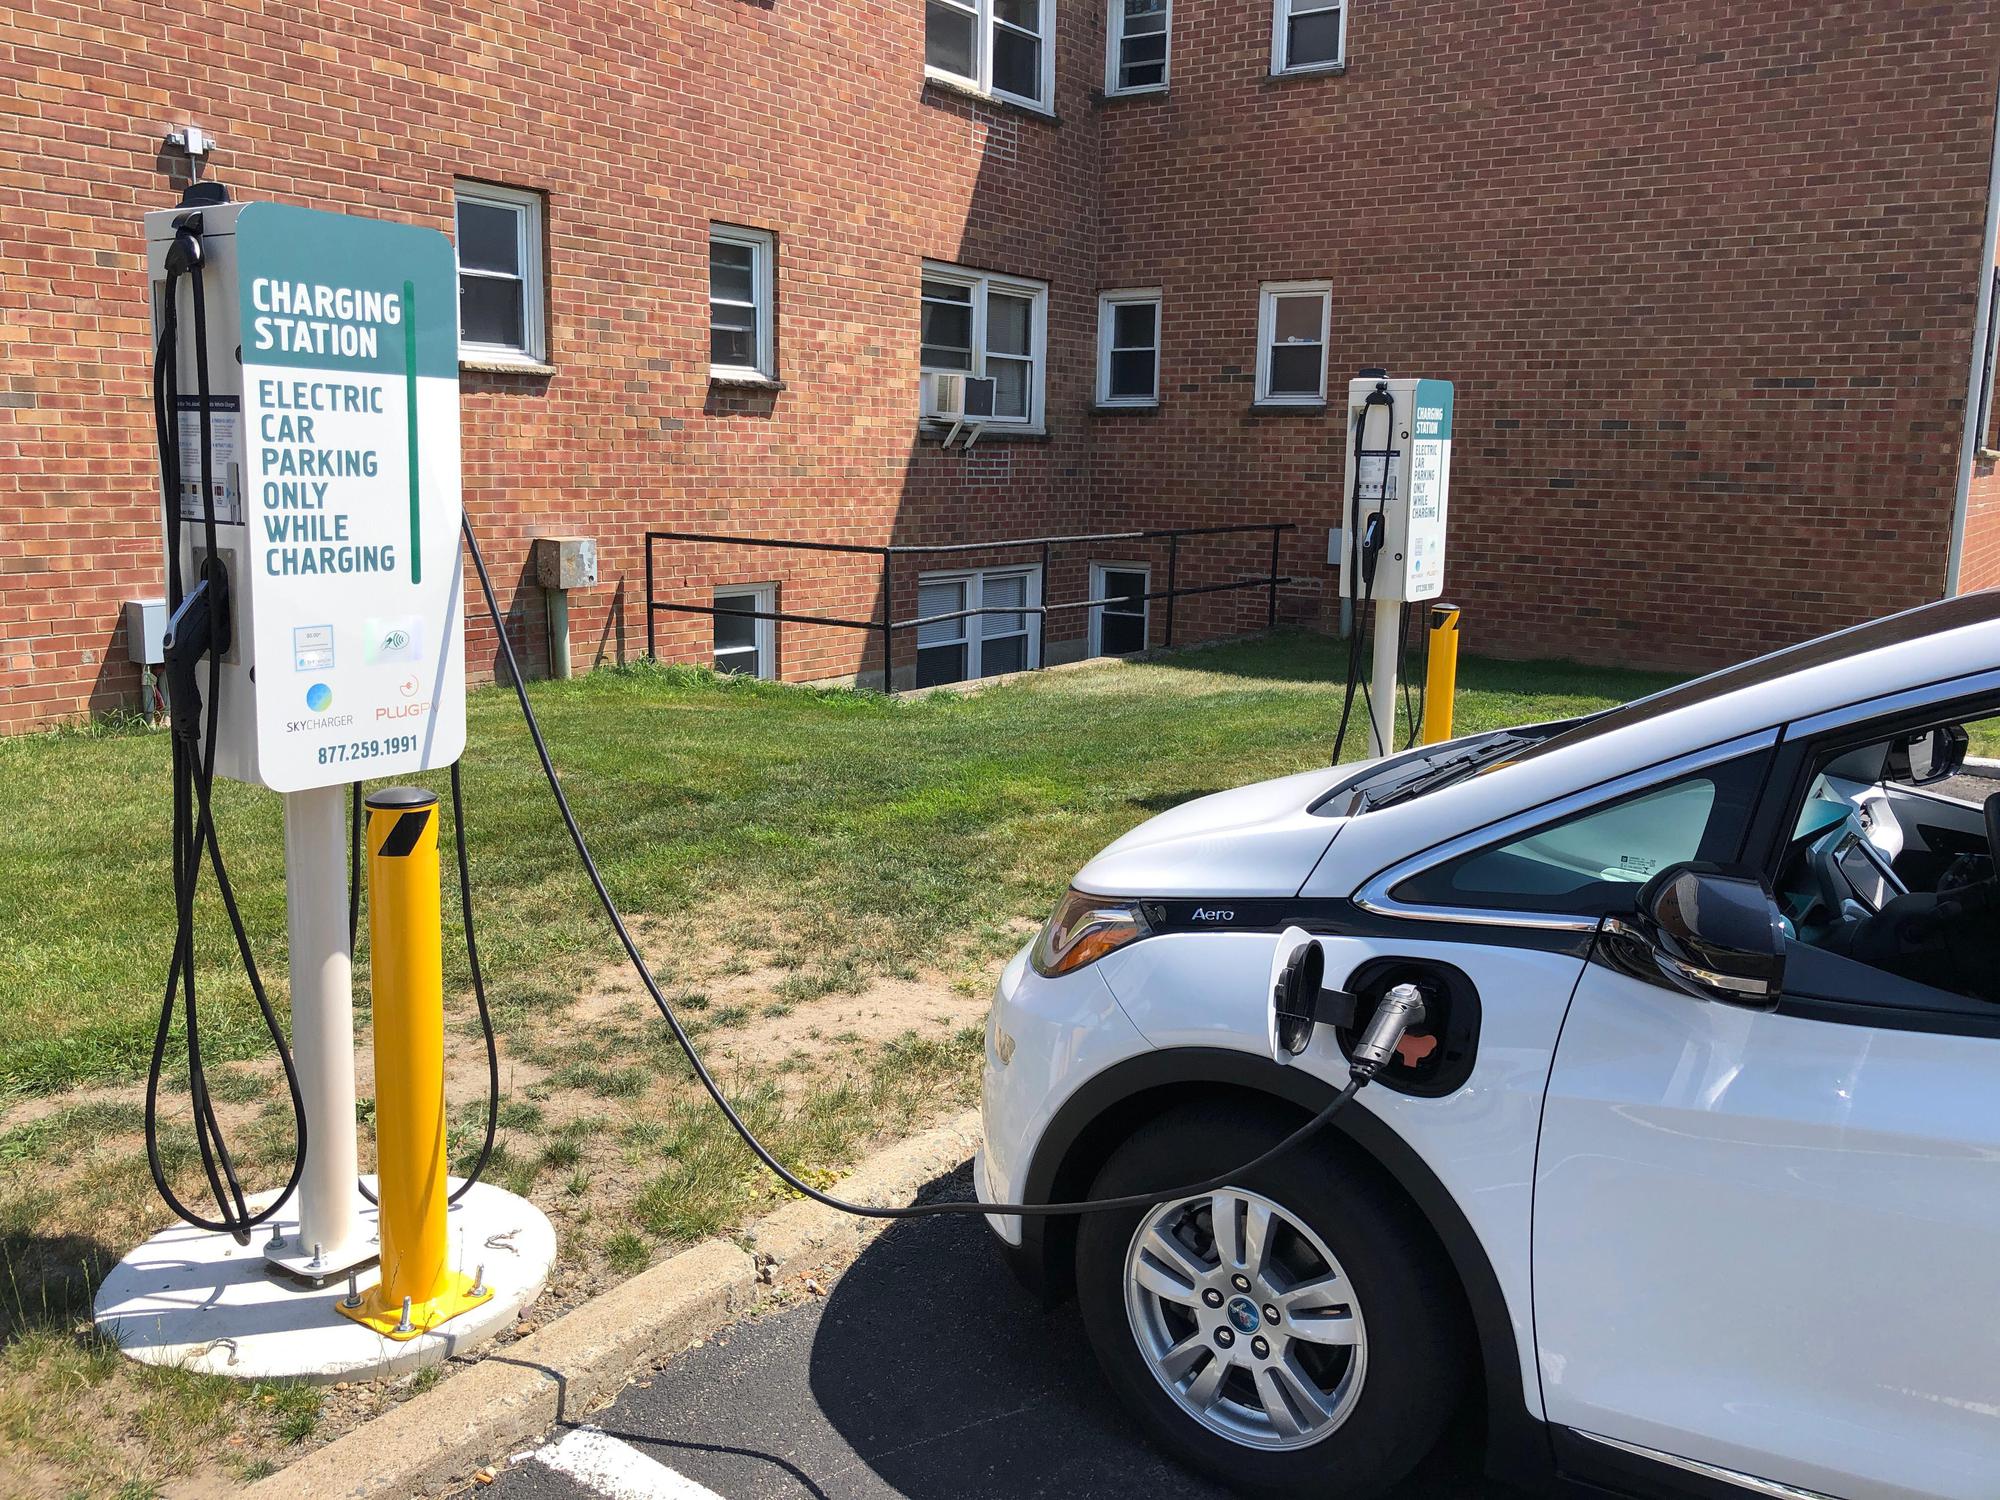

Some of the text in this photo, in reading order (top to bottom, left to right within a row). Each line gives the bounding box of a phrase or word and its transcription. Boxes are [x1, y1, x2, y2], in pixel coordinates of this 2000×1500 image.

[252, 277, 401, 325] CHARGING
[254, 316, 378, 359] STATION
[259, 379, 383, 414] ELECTRIC
[1417, 407, 1443, 421] CHARGING
[261, 413, 315, 443] CAR
[1416, 421, 1438, 434] STATION
[1415, 444, 1437, 456] ELECTRIC
[262, 447, 378, 478] PARKING
[1415, 457, 1425, 469] CAR
[1414, 469, 1435, 481] PARKING
[263, 481, 328, 510] ONLY
[1413, 482, 1426, 494] ONLY
[1413, 494, 1428, 506] WHILE
[1412, 507, 1435, 519] CHARGING
[264, 514, 349, 543] WHILE
[266, 544, 395, 577] CHARGING
[286, 714, 353, 733] SKYCHARGER
[318, 734, 418, 765] 877.259.1991
[1191, 907, 1235, 921] Aero
